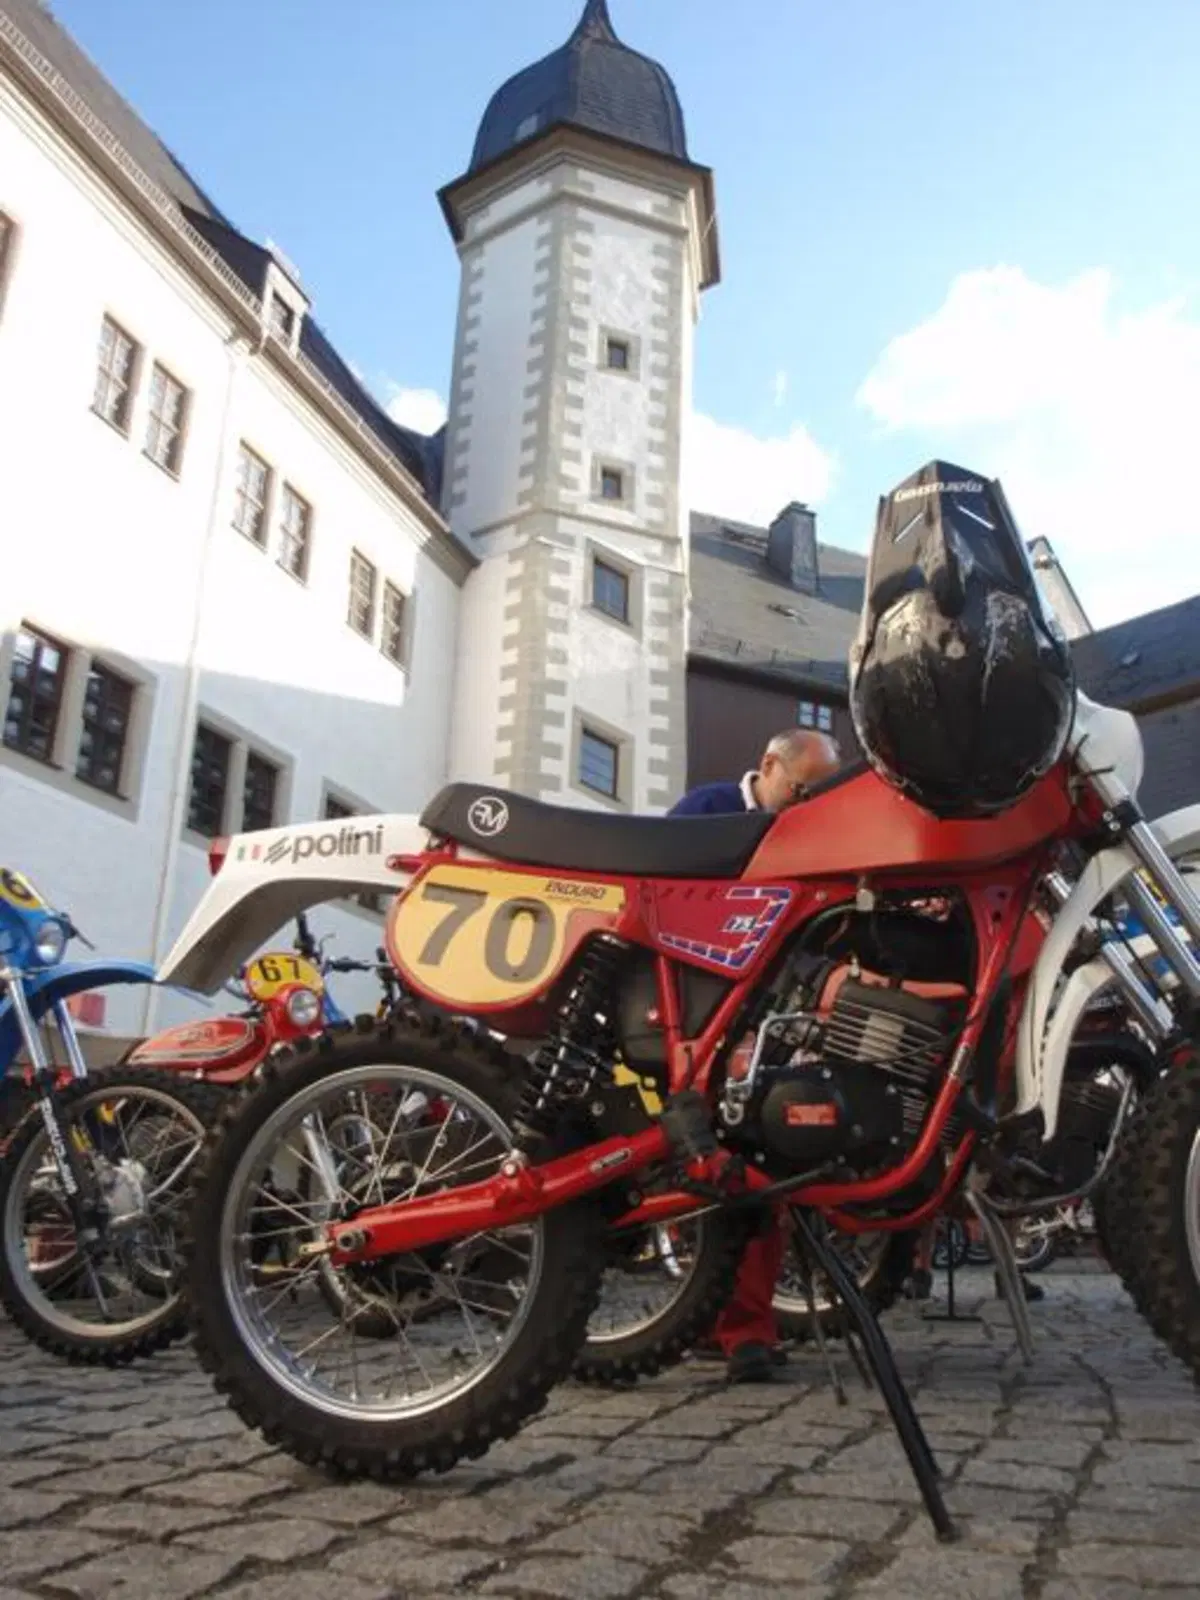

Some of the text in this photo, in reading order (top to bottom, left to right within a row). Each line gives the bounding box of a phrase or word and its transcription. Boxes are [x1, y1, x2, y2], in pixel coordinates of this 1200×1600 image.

[292, 825, 384, 864] polini
[545, 880, 606, 900] ENDURO
[417, 882, 556, 984] 70
[258, 957, 300, 982] 67
